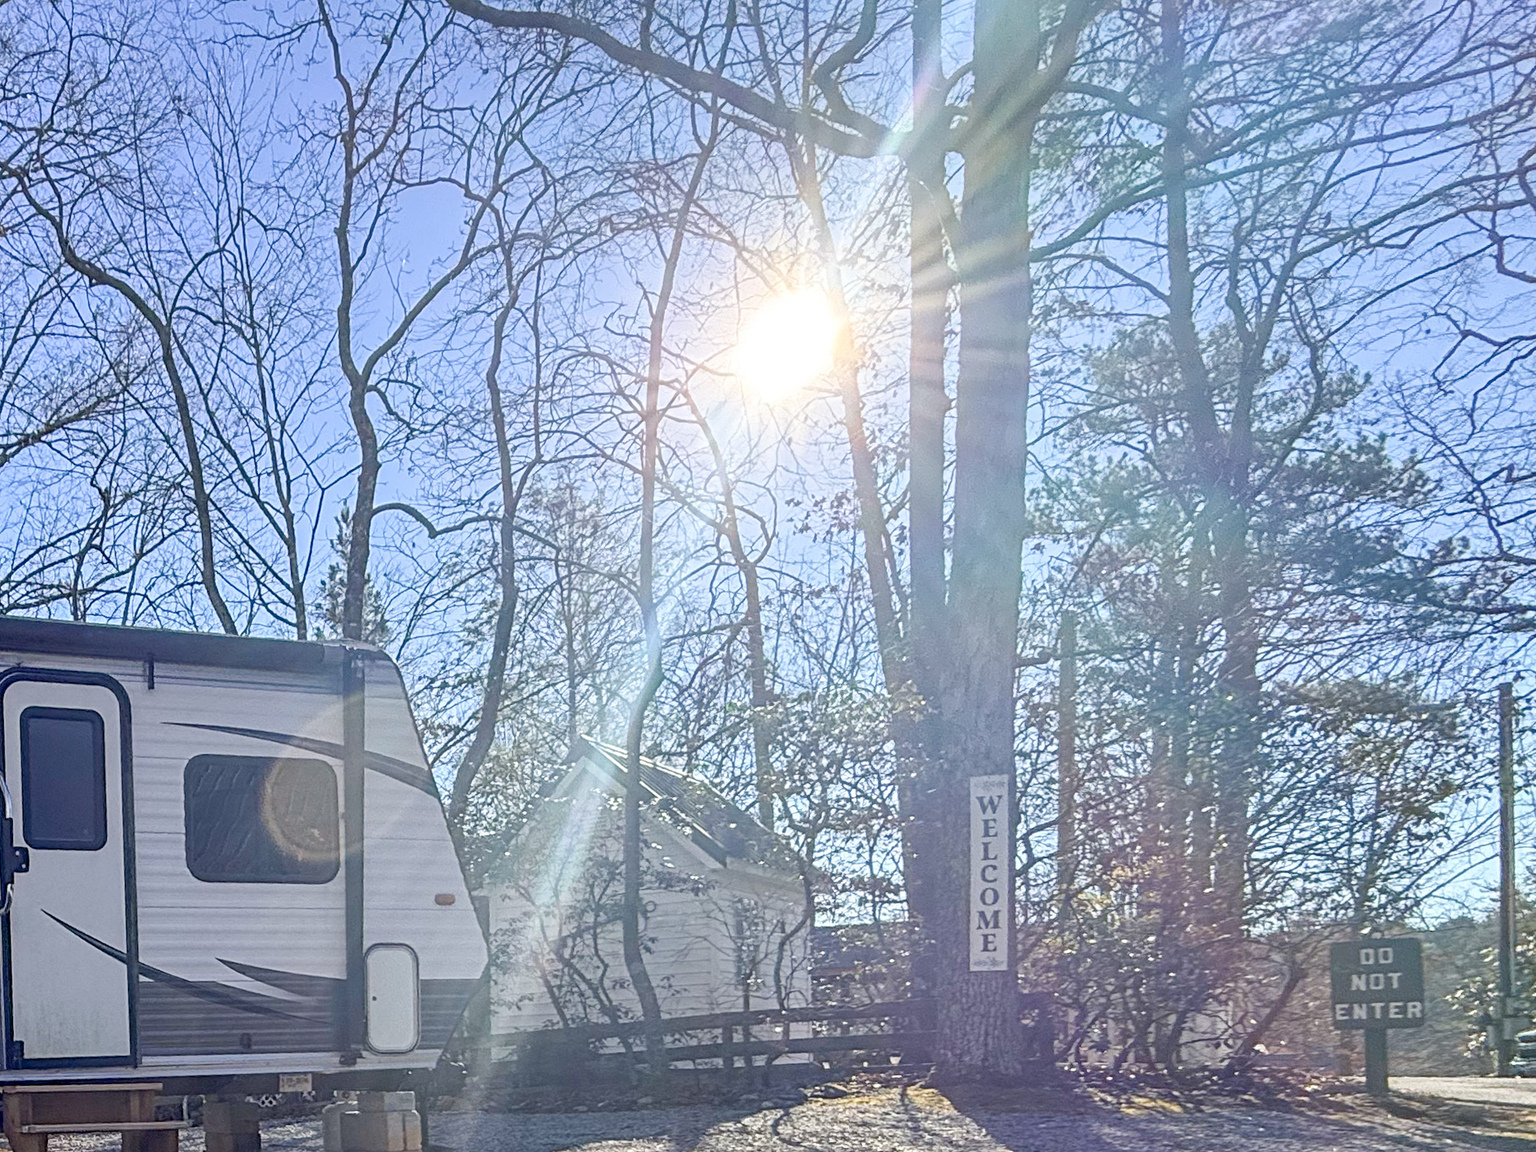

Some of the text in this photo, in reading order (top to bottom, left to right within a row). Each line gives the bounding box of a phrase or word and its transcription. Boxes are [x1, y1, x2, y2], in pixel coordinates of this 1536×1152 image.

[975, 794, 1003, 953] WELCOME
[1359, 947, 1394, 965] DO
[1350, 972, 1402, 991] NOT
[1335, 1002, 1423, 1020] ENTER
